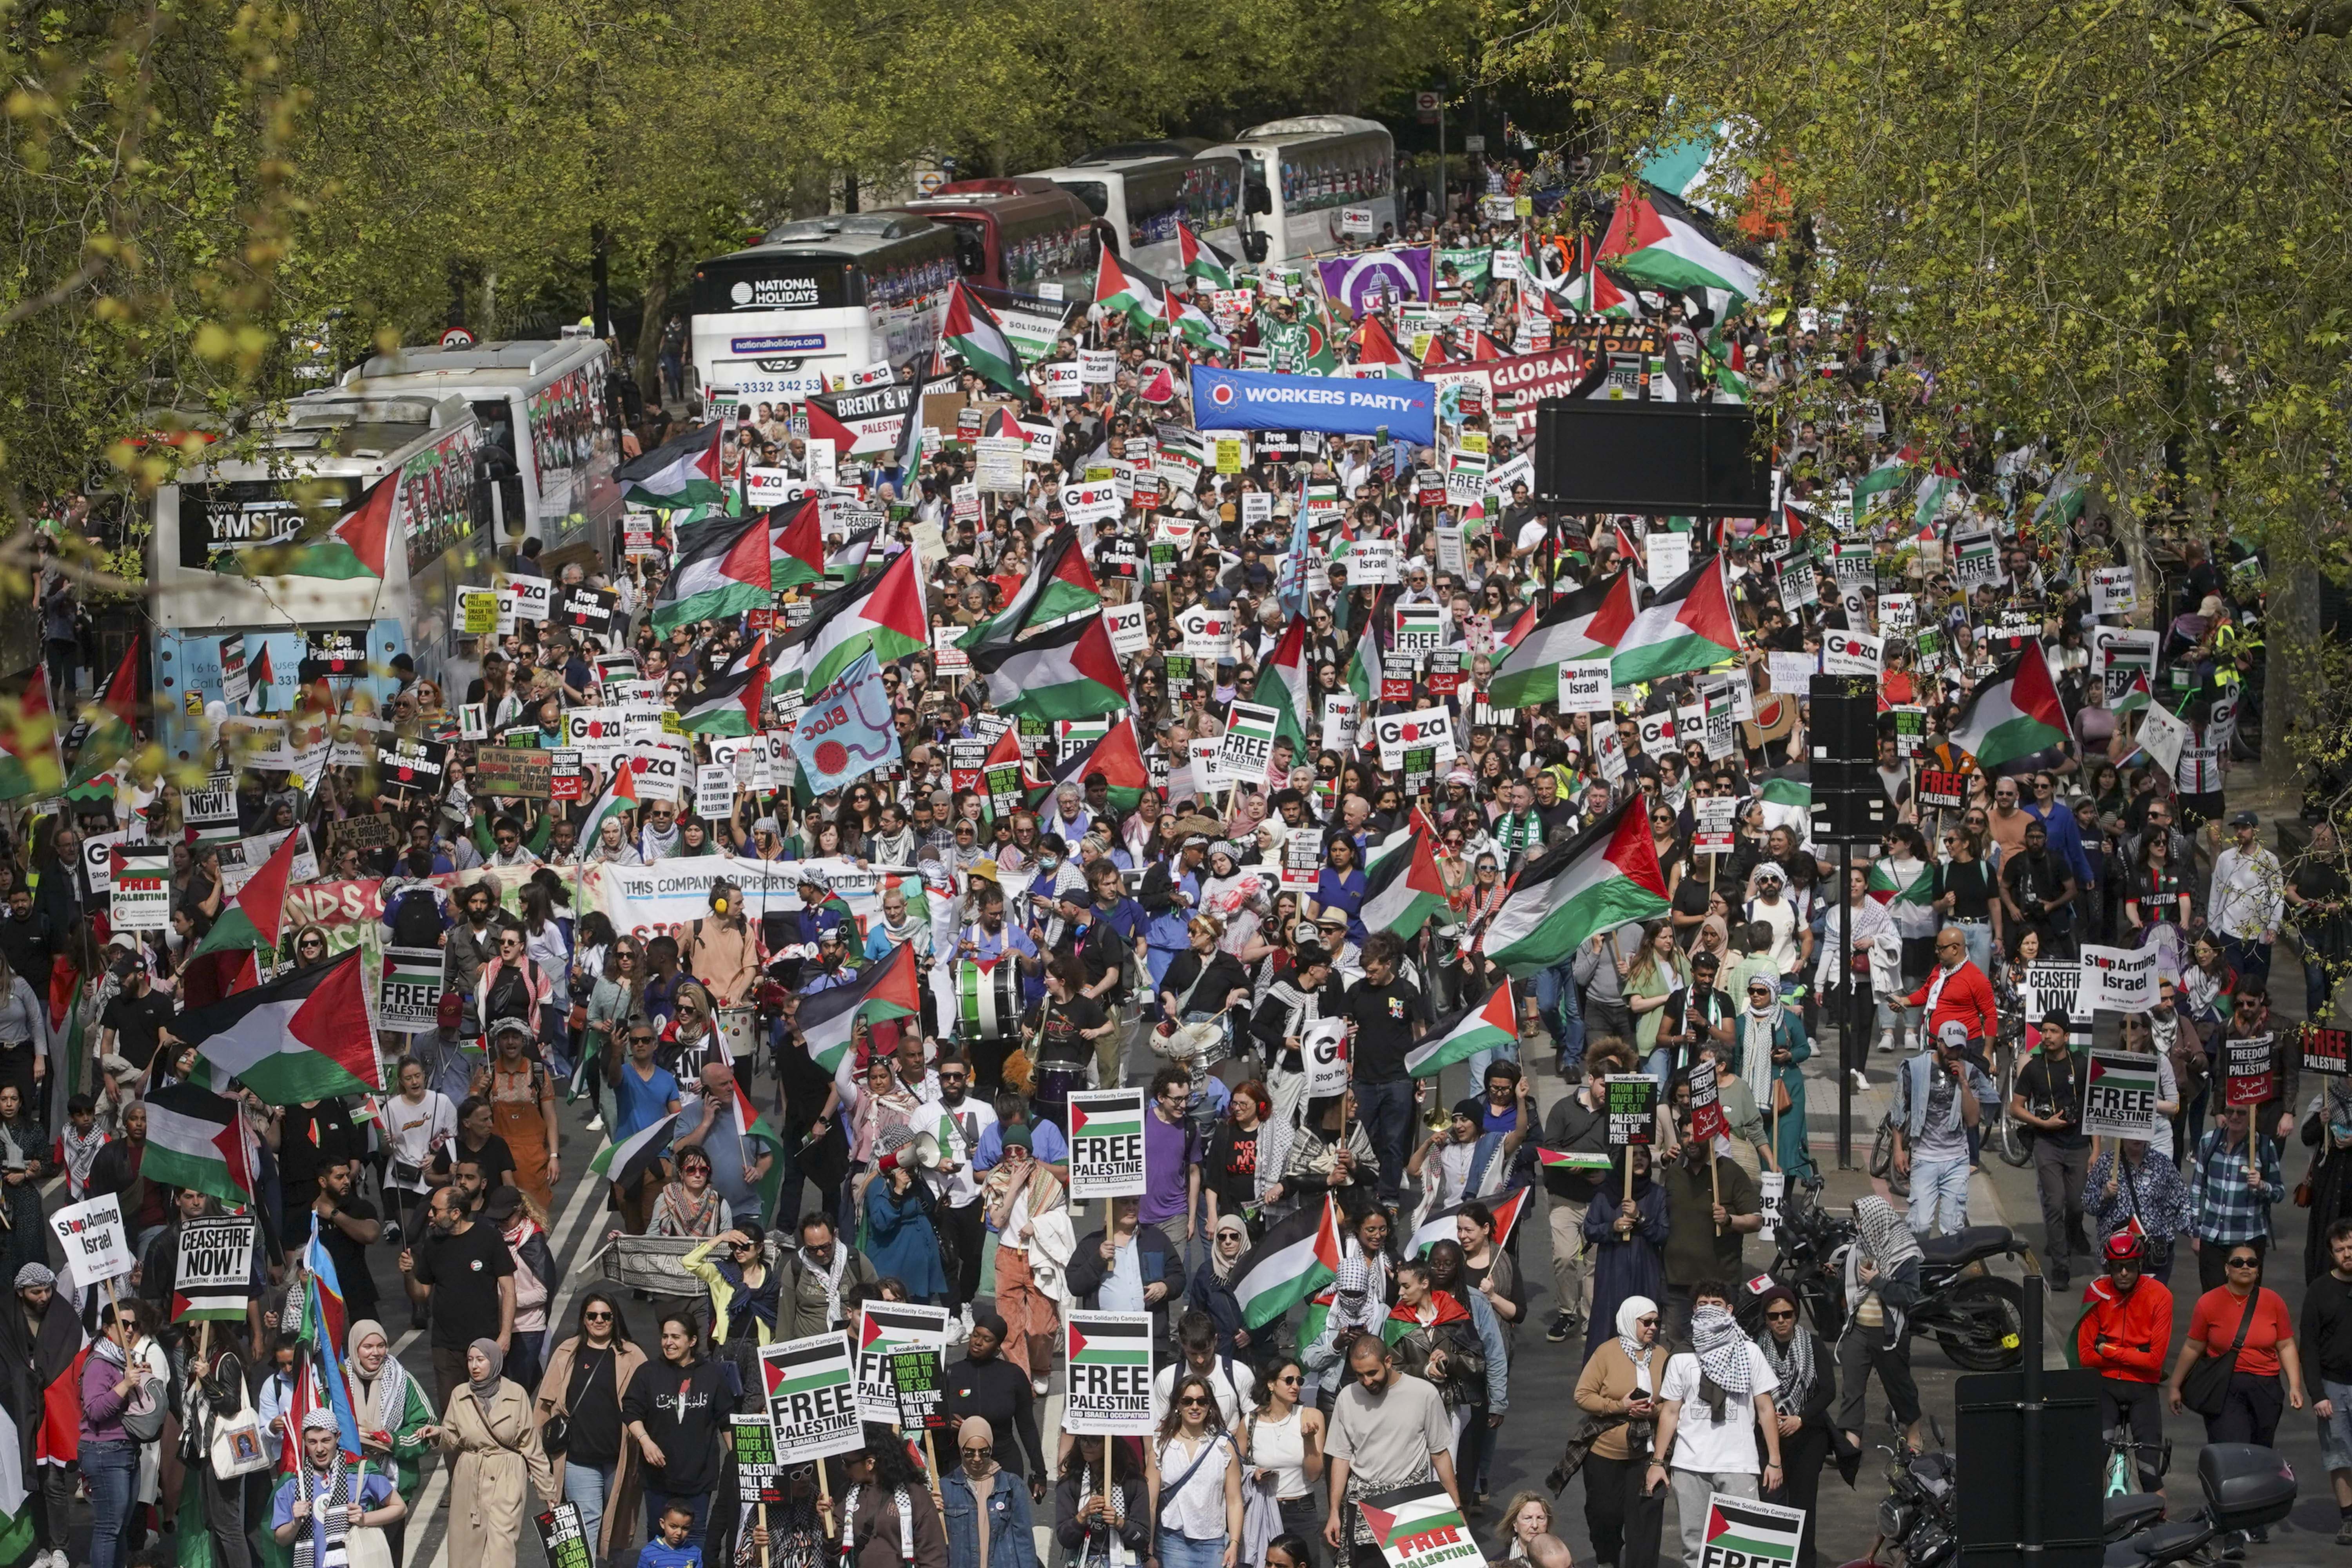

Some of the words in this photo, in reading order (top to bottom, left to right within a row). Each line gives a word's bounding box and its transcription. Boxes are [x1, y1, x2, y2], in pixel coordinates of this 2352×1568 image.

[755, 278, 818, 291] NATIONAL
[755, 290, 818, 303] HOLIDAYS
[1012, 299, 1063, 314] PALESTINE
[1009, 321, 1058, 335] SOLIDARIT
[1554, 325, 1646, 338] WOMEN
[736, 337, 822, 350] nationalholidays.com
[1080, 355, 1092, 363] Stp
[1094, 356, 1114, 364] Arming
[1086, 363, 1108, 372] Israel
[1493, 354, 1580, 386] GLOBAL
[1609, 371, 1639, 385] FREE
[837, 394, 880, 417] BRENT
[884, 392, 895, 408] &
[1245, 387, 1345, 406] WORKERS
[1350, 395, 1411, 412] PARTY
[708, 405, 737, 416] FREE
[862, 420, 904, 434] PALESTIN
[1265, 432, 1287, 443] Free
[1255, 441, 1299, 453] Palestine
[1448, 472, 1482, 490] FREE
[1446, 486, 1482, 498] PALESTINE
[1835, 559, 1874, 573] FREE
[1958, 555, 1995, 574] FREE
[1779, 570, 1813, 588] FREE
[1837, 572, 1875, 580] PALESTINE
[575, 589, 598, 604] Free
[563, 599, 610, 619] Palestine
[2001, 612, 2028, 625] Free
[1988, 623, 2042, 640] Palestine
[1397, 633, 1439, 648] FREE
[191, 663, 204, 674] 16
[207, 663, 219, 674] to
[1561, 669, 1577, 681] Stp
[1579, 667, 1608, 679] Arming
[191, 678, 214, 689] Call
[1570, 681, 1599, 694] Israel
[571, 716, 621, 739] Gza
[1707, 713, 1731, 732] FREE
[1707, 730, 1732, 745] PALESTINE
[954, 746, 985, 756] FREEDOM
[1222, 733, 1270, 759] FREE
[481, 753, 493, 763] ON
[495, 753, 510, 763] THIS
[1220, 751, 1266, 768] PALESTINE
[2182, 748, 2217, 759] PALESTINE
[377, 748, 441, 775] Palestine
[988, 771, 1003, 781] FROM
[1005, 769, 1017, 778] THE
[639, 779, 674, 789] massacre
[991, 785, 1004, 794] THE
[1004, 783, 1016, 792] SEA
[1920, 770, 1962, 796] FREE
[711, 792, 730, 801] DEFEND
[993, 790, 1023, 802] PALESTINE
[1405, 787, 1419, 796] FREE
[1919, 792, 1960, 807] PALESTINE
[701, 803, 730, 812] PALESTINE!
[996, 807, 1011, 817] FREE
[332, 822, 350, 831] LET
[354, 815, 380, 826] GAZA
[358, 825, 391, 837] BREATHE
[92, 871, 109, 879] Stop
[120, 877, 161, 892] FREE
[625, 881, 653, 894] THIS
[728, 874, 796, 890] SUPPORTS
[113, 893, 167, 902] PALESTINE
[2085, 953, 2115, 971] Stp
[2118, 953, 2156, 972] Arming
[381, 983, 440, 1006] FREE
[380, 1004, 437, 1017] PALESTINE
[2231, 1047, 2270, 1060] FREEDOM
[2229, 1059, 2271, 1076] PALESTINE
[1611, 1083, 1634, 1093] FROM
[1636, 1083, 1650, 1093] THE
[1610, 1093, 1633, 1103] RIVER
[1635, 1094, 1646, 1103] TO
[2087, 1086, 2154, 1112] FREE
[1610, 1103, 1625, 1113] THE
[1628, 1104, 1642, 1113] SEA
[2086, 1107, 2152, 1122] PALESTINE
[1610, 1113, 1651, 1124] PALESTINE
[1609, 1123, 1628, 1134] WILL
[1630, 1123, 1641, 1134] BE
[1609, 1134, 1628, 1144] FREE
[1072, 1135, 1142, 1164] FREE
[1073, 1161, 1142, 1176] PALESTINE
[58, 1218, 87, 1237] Stp
[87, 1207, 119, 1229] Arming
[80, 1230, 113, 1255] Israel
[181, 1228, 250, 1252] CEASEFIRE
[186, 1249, 242, 1278] NOW!
[865, 1304, 889, 1313] Palestine
[890, 1306, 916, 1316] Solidarity
[918, 1309, 946, 1318] Campaign
[1069, 1313, 1093, 1321] Palestine
[1094, 1314, 1120, 1323] Solidarity
[894, 1355, 918, 1366] FROM
[920, 1353, 935, 1365] THE
[898, 1380, 914, 1391] THE
[915, 1379, 931, 1390] SEA
[1069, 1365, 1149, 1395] FREE
[900, 1390, 943, 1404] PALESTINE
[1070, 1395, 1149, 1410] PALESTINE
[769, 1383, 855, 1427] FREE
[775, 1412, 858, 1441] PALESTINE
[739, 1476, 760, 1489] WILL
[761, 1475, 773, 1488] BE
[740, 1489, 760, 1501] FREE
[553, 1503, 575, 1519] FREE
[556, 1514, 578, 1530] WILL
[1394, 1524, 1461, 1559] FREE
